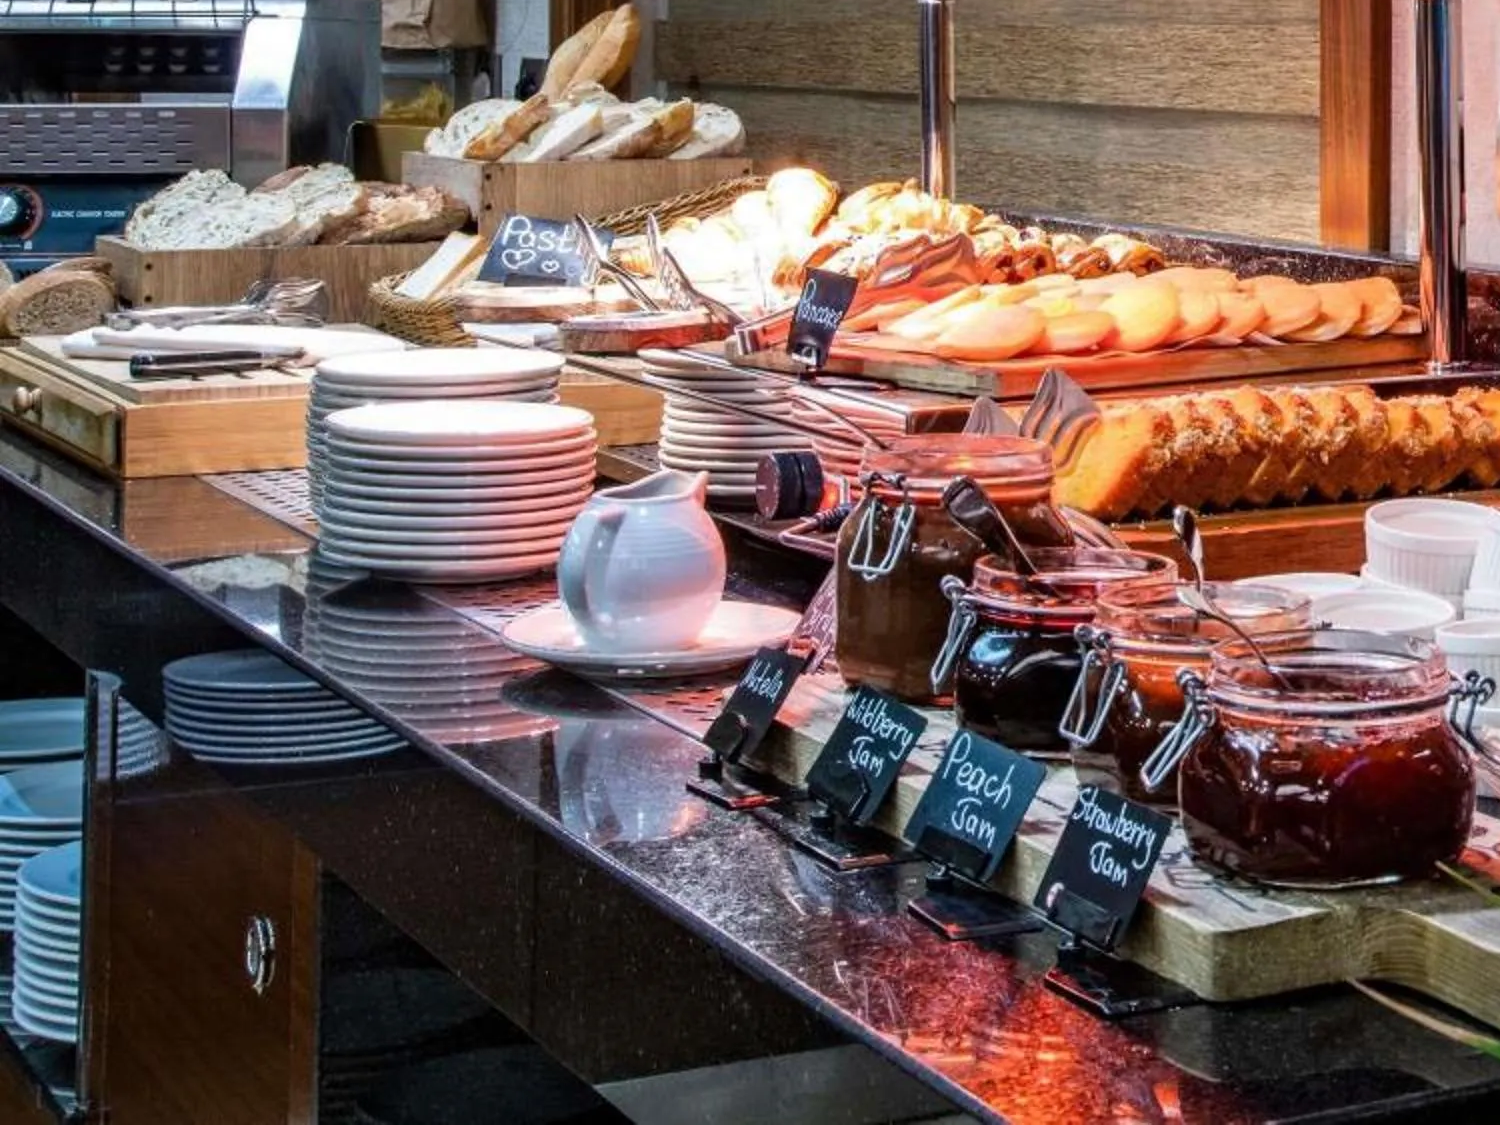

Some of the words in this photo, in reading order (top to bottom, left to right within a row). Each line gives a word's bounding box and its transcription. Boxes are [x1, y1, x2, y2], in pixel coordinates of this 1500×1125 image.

[848, 736, 884, 778] Jam
[942, 732, 1015, 810] Peach
[951, 796, 996, 849] Jam
[1072, 786, 1157, 870] Strawberry
[1089, 840, 1128, 888] Jam
